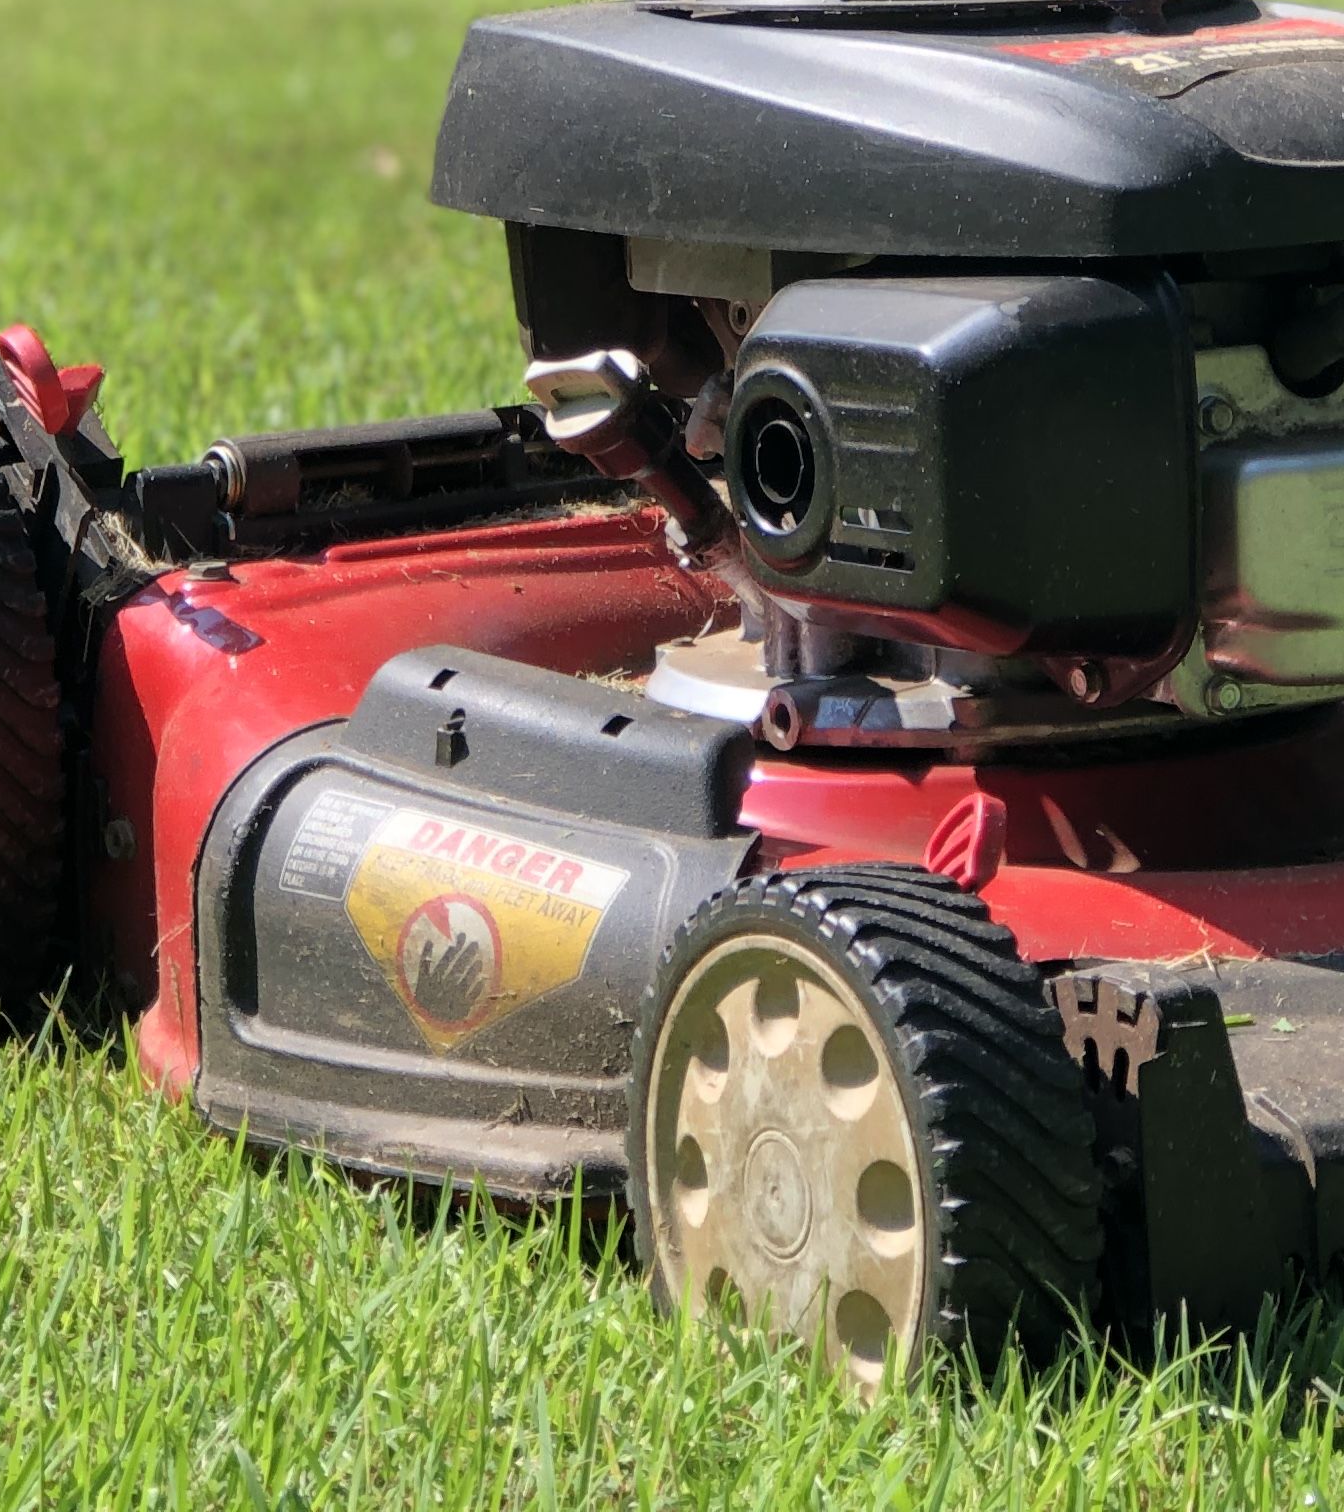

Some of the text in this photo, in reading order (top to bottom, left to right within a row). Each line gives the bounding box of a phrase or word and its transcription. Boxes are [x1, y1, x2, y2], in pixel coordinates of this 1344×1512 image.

[408, 819, 584, 895] DANGER
[493, 883, 536, 910] FEET
[536, 895, 593, 928] AWAY
